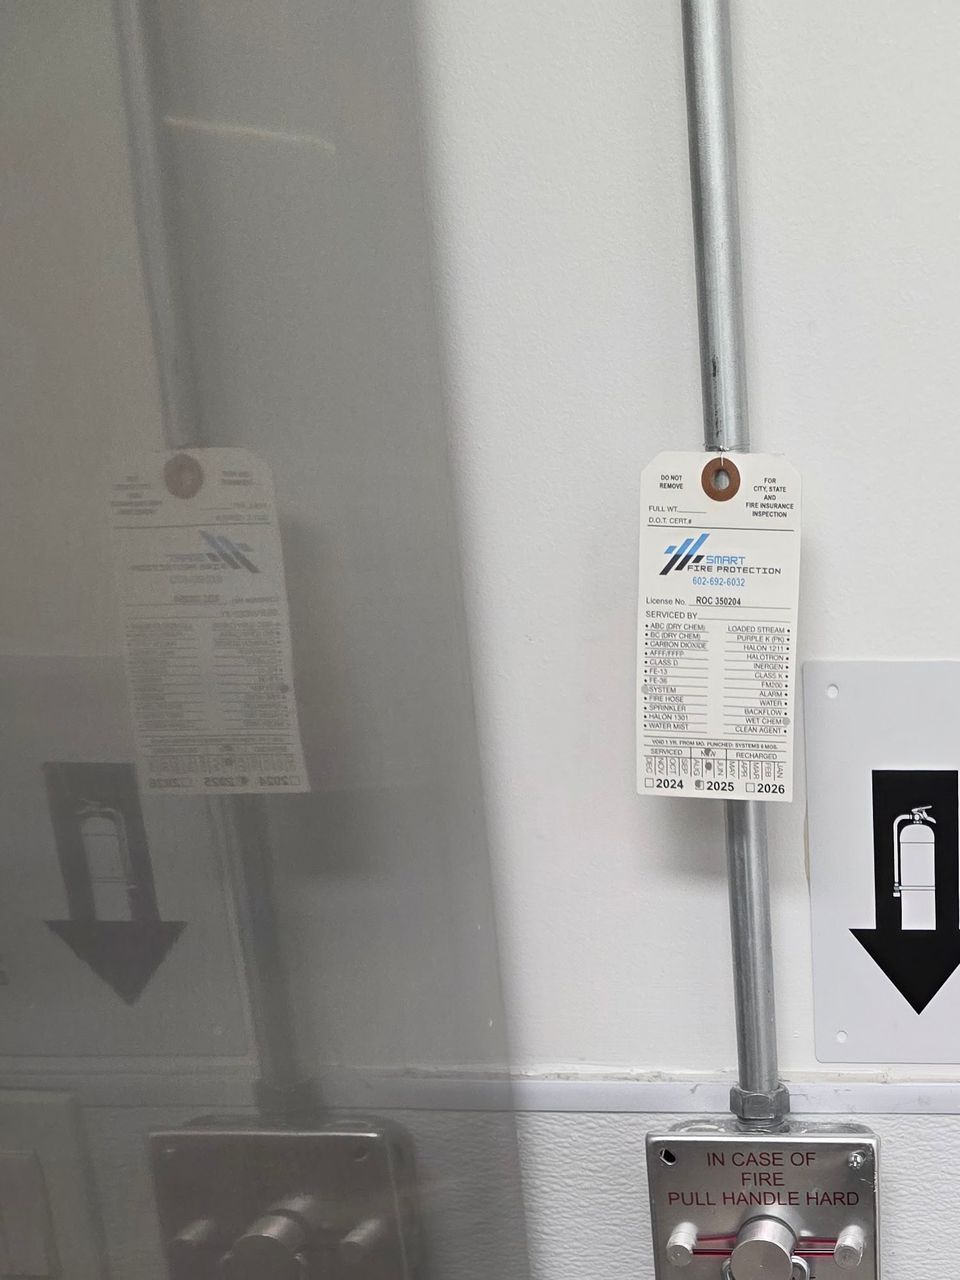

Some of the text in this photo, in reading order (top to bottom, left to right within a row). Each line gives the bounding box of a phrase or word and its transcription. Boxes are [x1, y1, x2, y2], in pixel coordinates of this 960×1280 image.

[660, 474, 670, 482] DO
[659, 482, 684, 490] REMOVE
[760, 502, 794, 510] INSURANCE
[752, 510, 788, 518] INSPECTION
[706, 555, 746, 566] SMART
[687, 564, 782, 574] FIRE PROTECTION
[692, 576, 746, 587] 602-692-6032
[646, 596, 742, 606] License No. ROC 350204
[646, 610, 698, 620] SERVICED BY
[656, 778, 785, 794] 2024 2025 2026
[706, 1152, 816, 1166] IN CASE OF
[741, 1172, 785, 1187] FIRE
[668, 1191, 860, 1206] PULL HANDLE HARD
